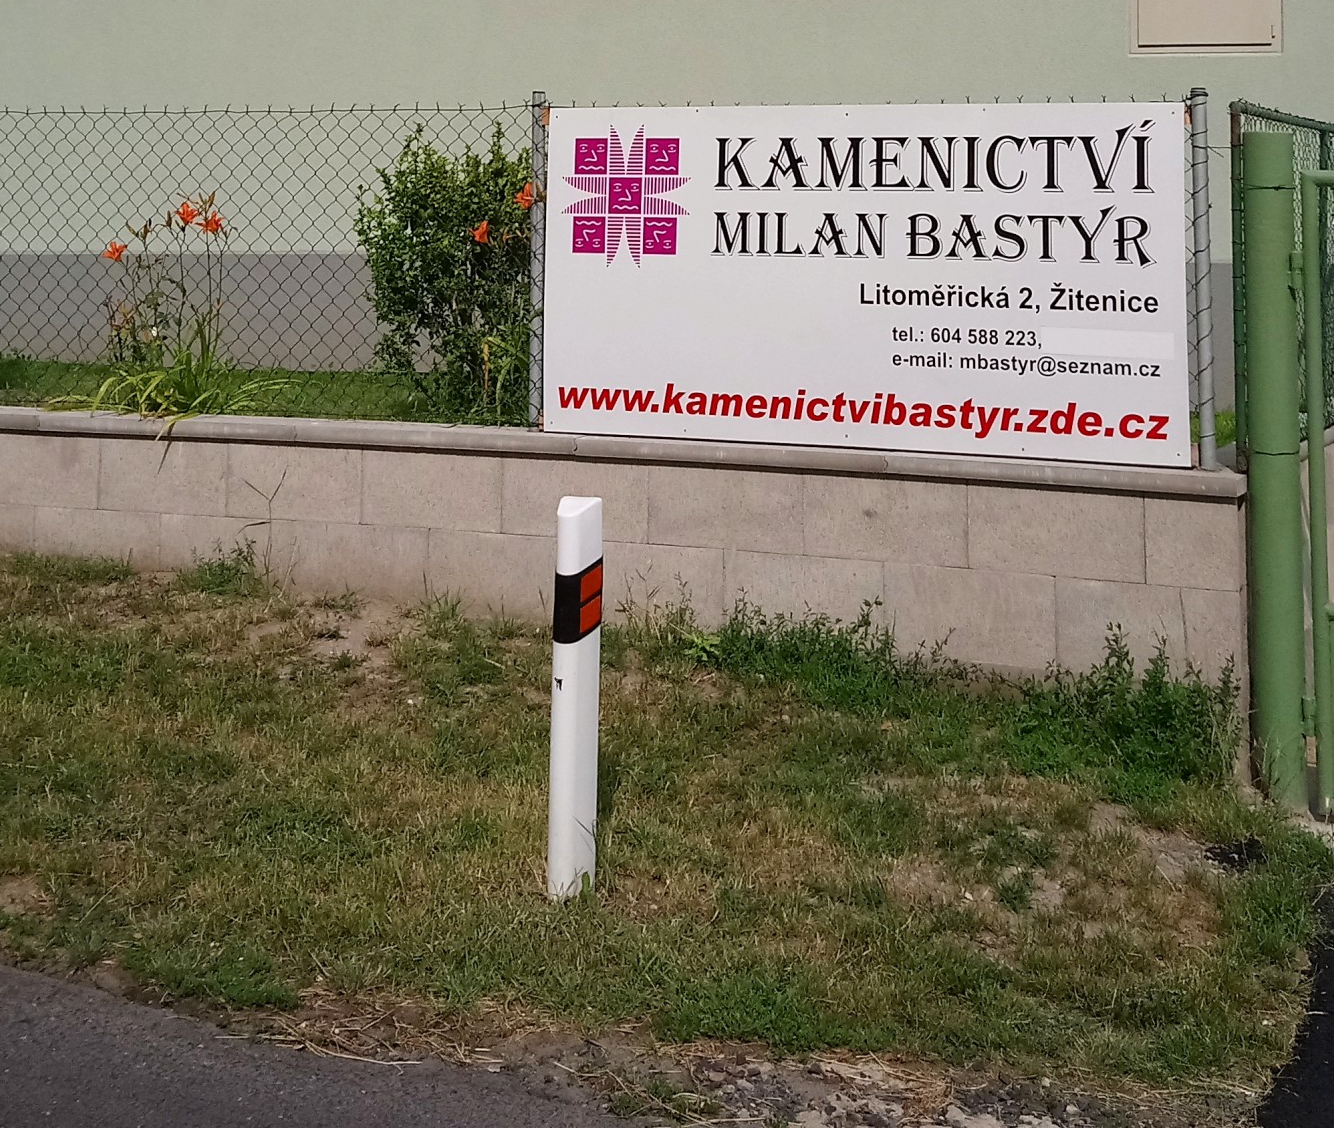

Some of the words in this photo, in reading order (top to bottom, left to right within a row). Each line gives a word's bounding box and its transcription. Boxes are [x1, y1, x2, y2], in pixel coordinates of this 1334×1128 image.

[712, 120, 1156, 194] KAMENICTVÍ
[711, 212, 889, 259] MILAN
[859, 283, 1011, 309] Litoměřická
[1018, 287, 1043, 314] 2,
[1049, 282, 1160, 314] Žitenice
[891, 326, 925, 343] tel.:
[930, 327, 963, 345] 604
[967, 329, 999, 346] 588
[1005, 330, 1044, 350] 223,
[891, 353, 954, 369] e-mail:
[959, 353, 1162, 379] mbastyr@seznam.cz
[557, 382, 1171, 442] www.kamenictvibastyr.zde.cz
